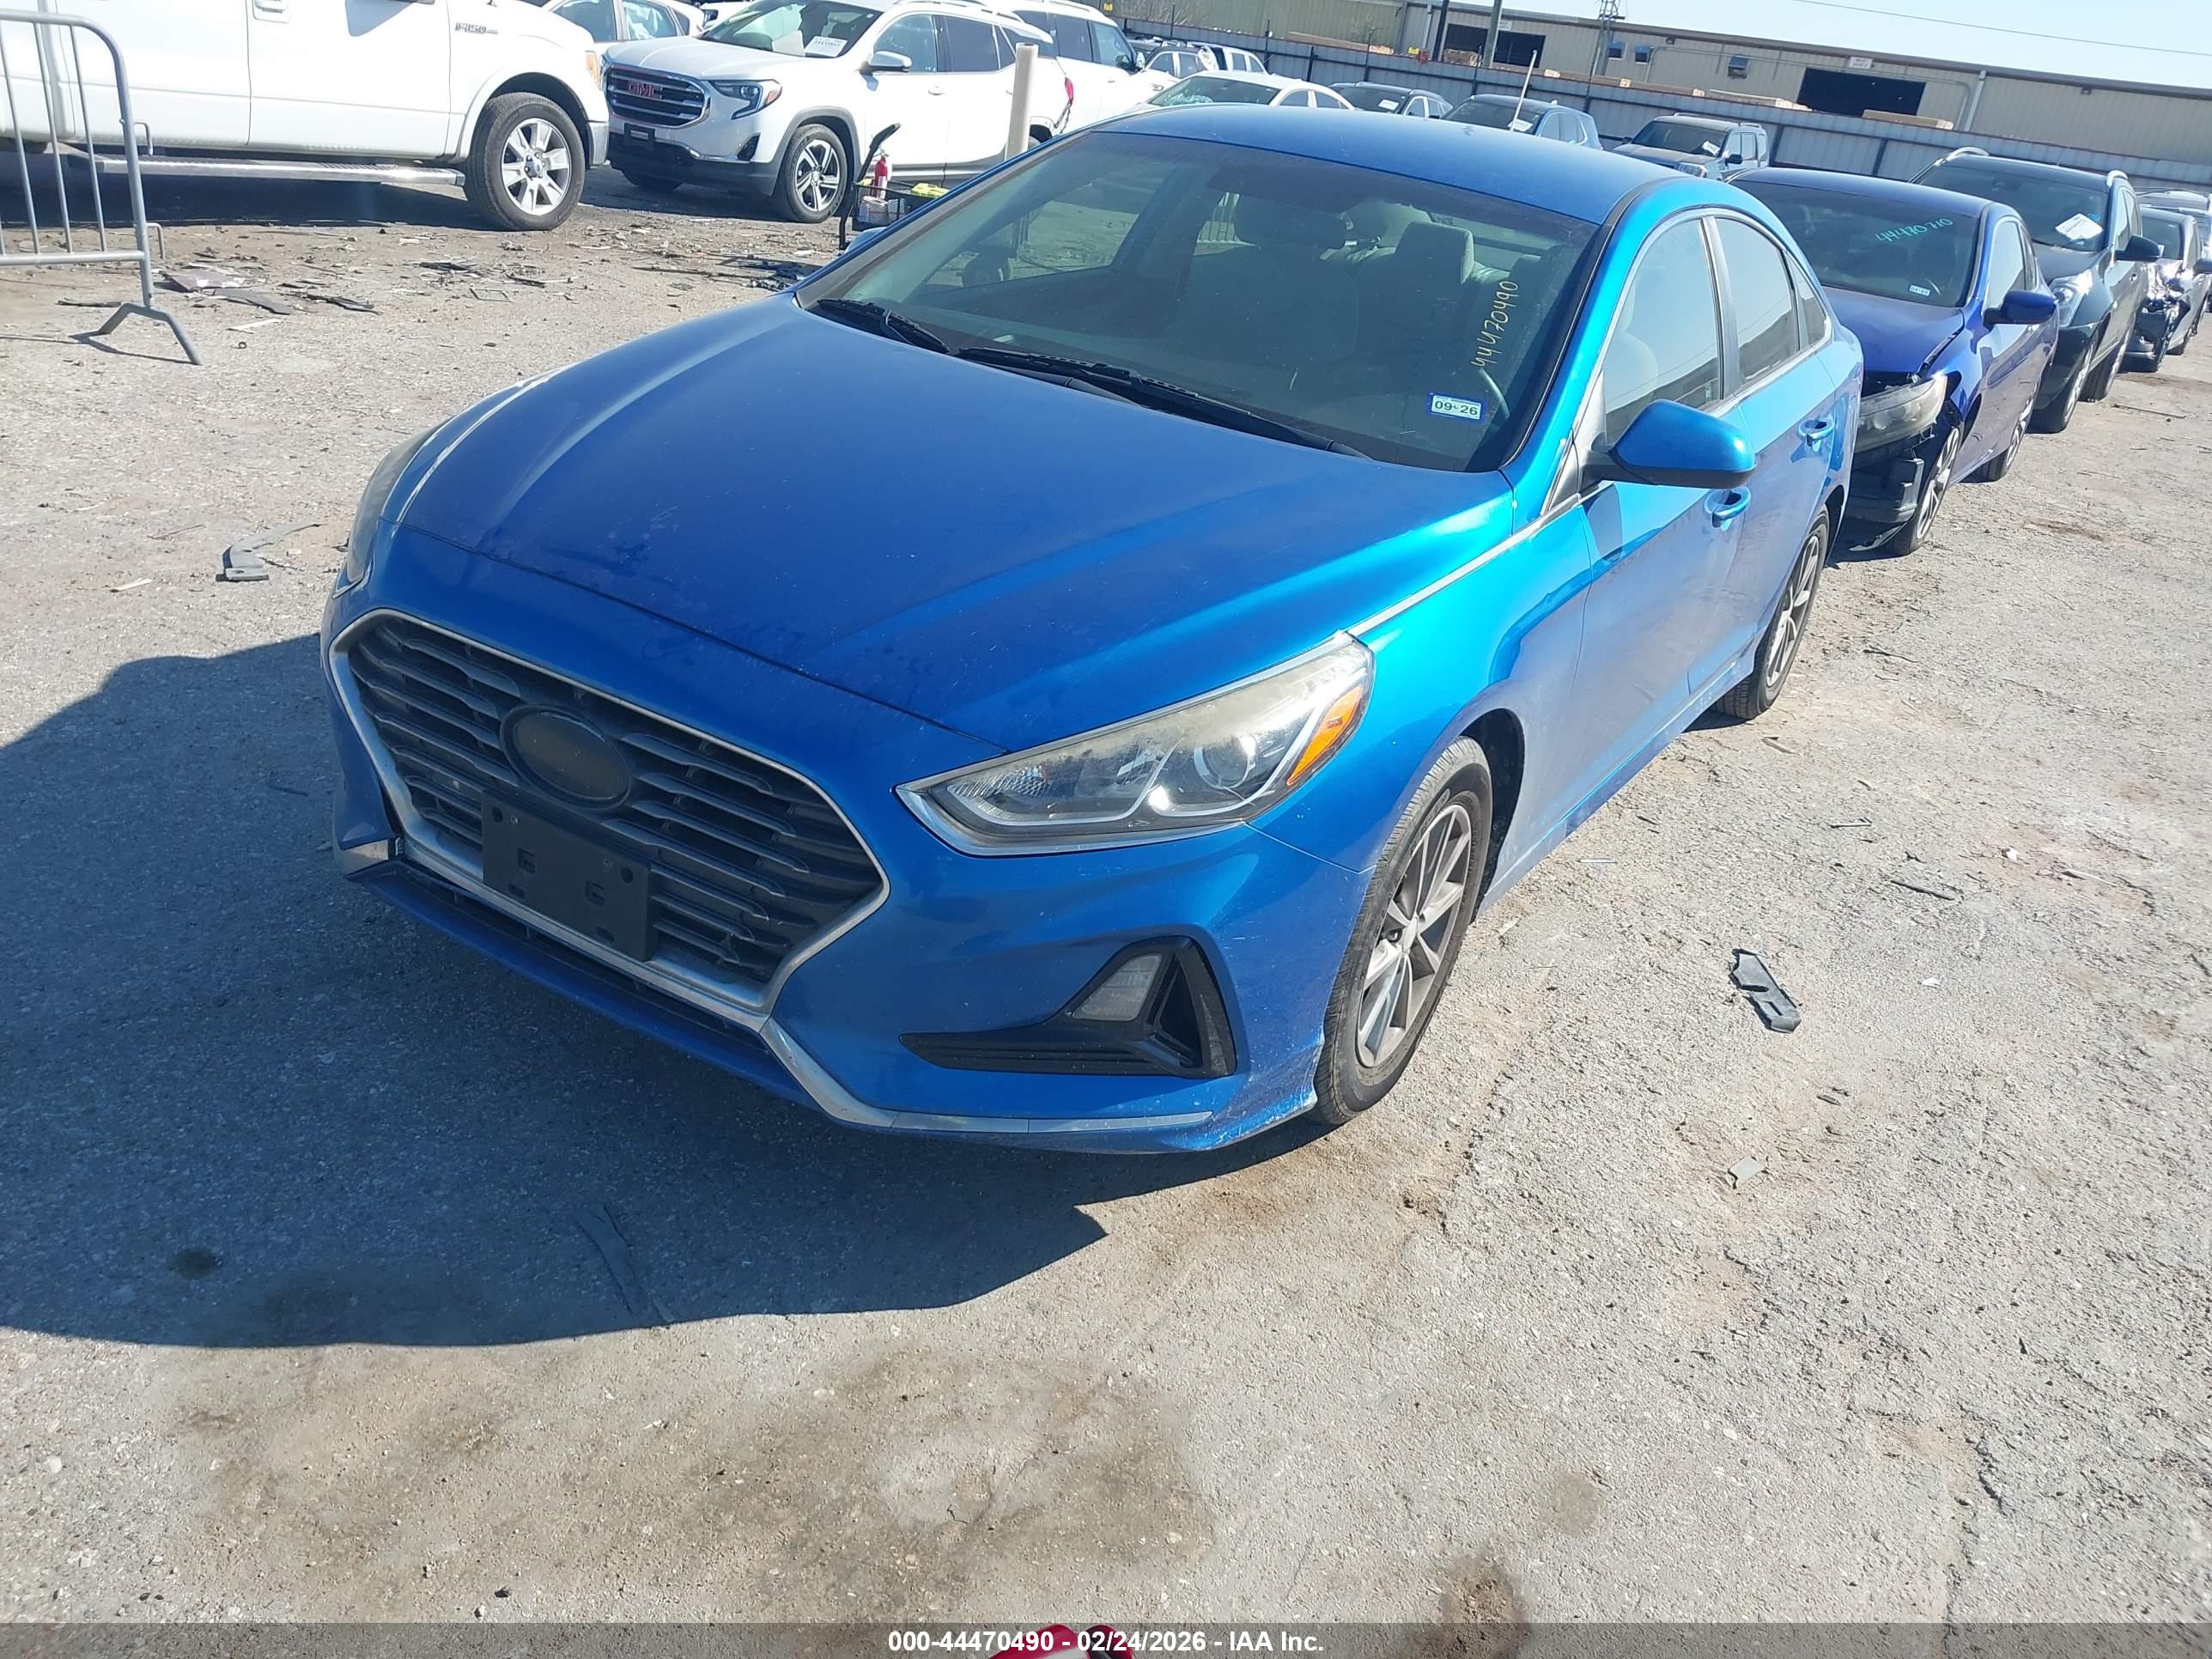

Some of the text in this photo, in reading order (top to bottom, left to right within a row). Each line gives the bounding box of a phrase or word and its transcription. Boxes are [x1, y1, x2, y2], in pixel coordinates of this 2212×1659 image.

[627, 81, 663, 100] GMC
[1470, 281, 1519, 367] 44470490
[1434, 400, 1478, 416] 09 26
